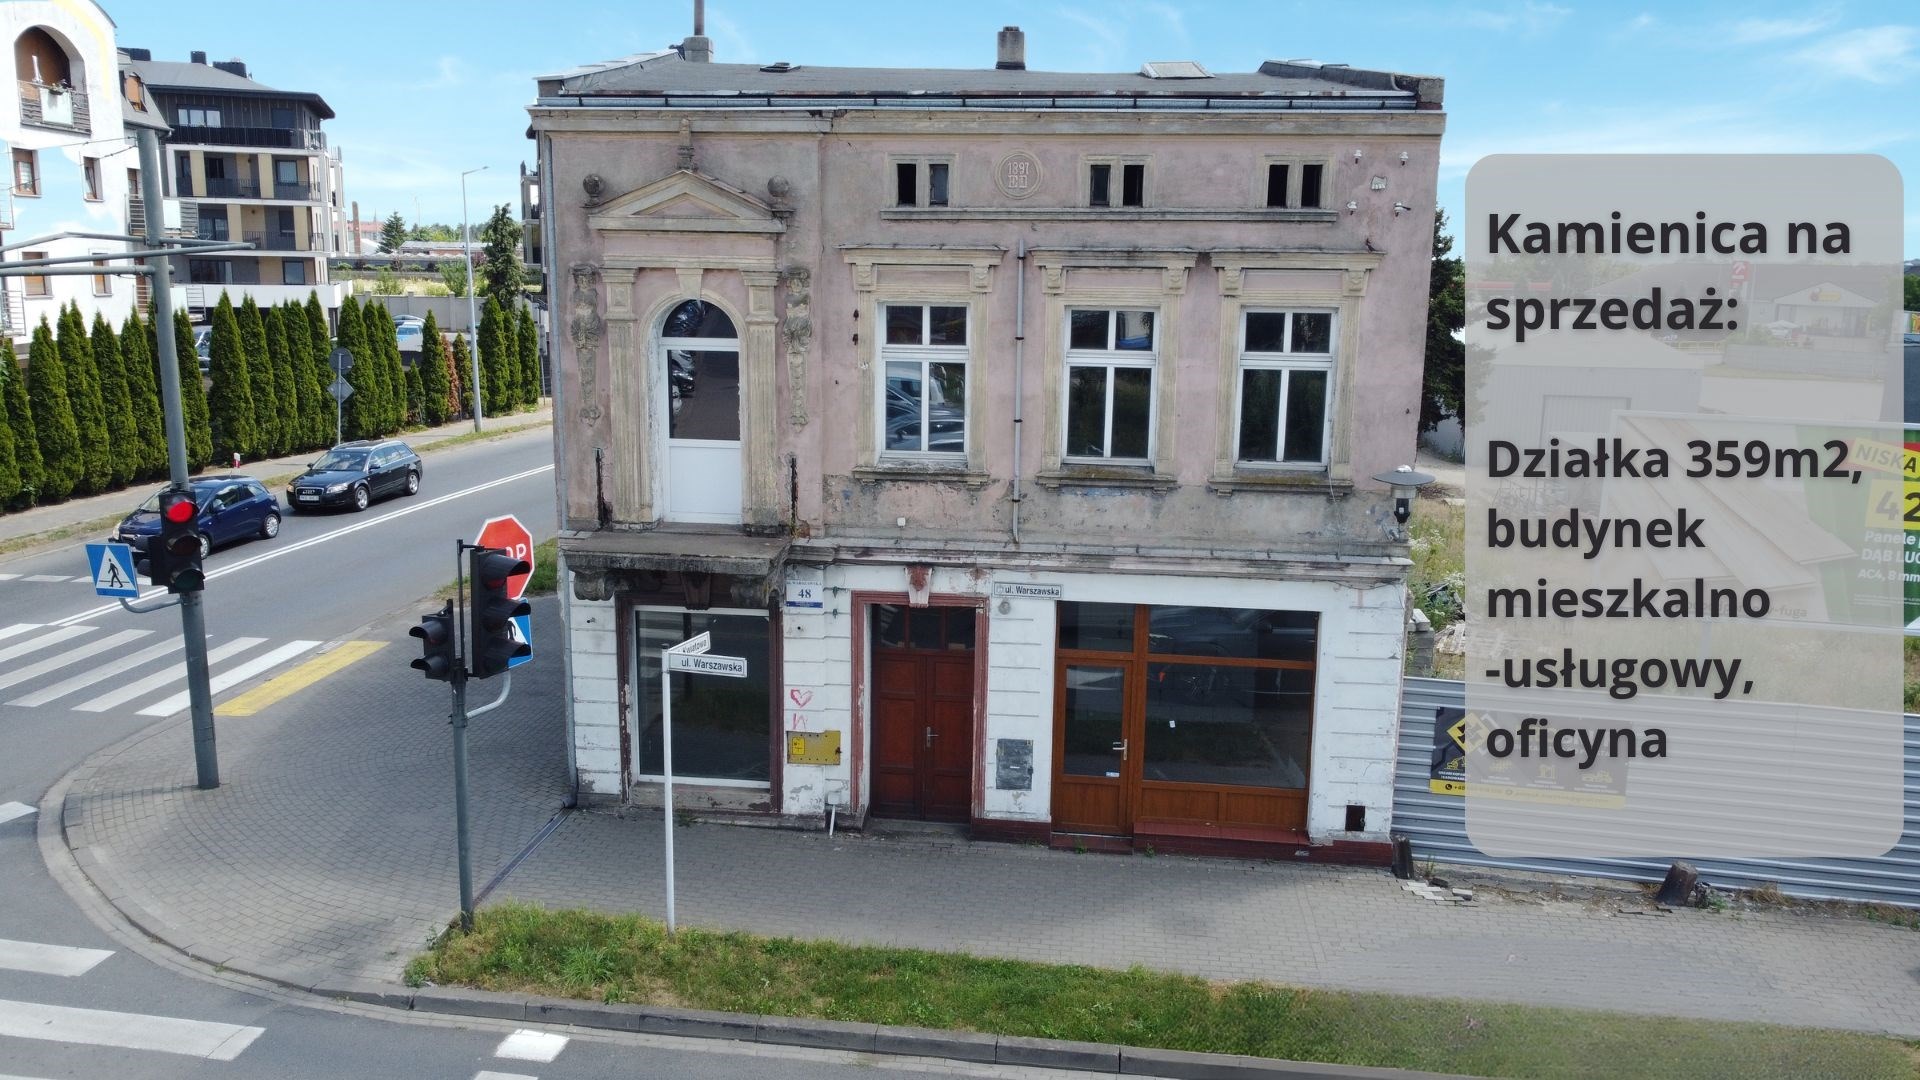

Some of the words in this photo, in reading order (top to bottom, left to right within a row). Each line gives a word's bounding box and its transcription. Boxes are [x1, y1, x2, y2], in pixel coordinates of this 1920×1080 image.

[1855, 443, 1917, 473] NISKA
[1864, 529, 1917, 546] Panele
[1861, 547, 1894, 565] DĄB
[798, 588, 812, 599] 48
[1005, 586, 1014, 594] ul.
[1016, 586, 1059, 596] Warszawska
[682, 640, 707, 653] Kwiatowa
[681, 657, 692, 668] ul.
[693, 658, 743, 673] Warszawska
